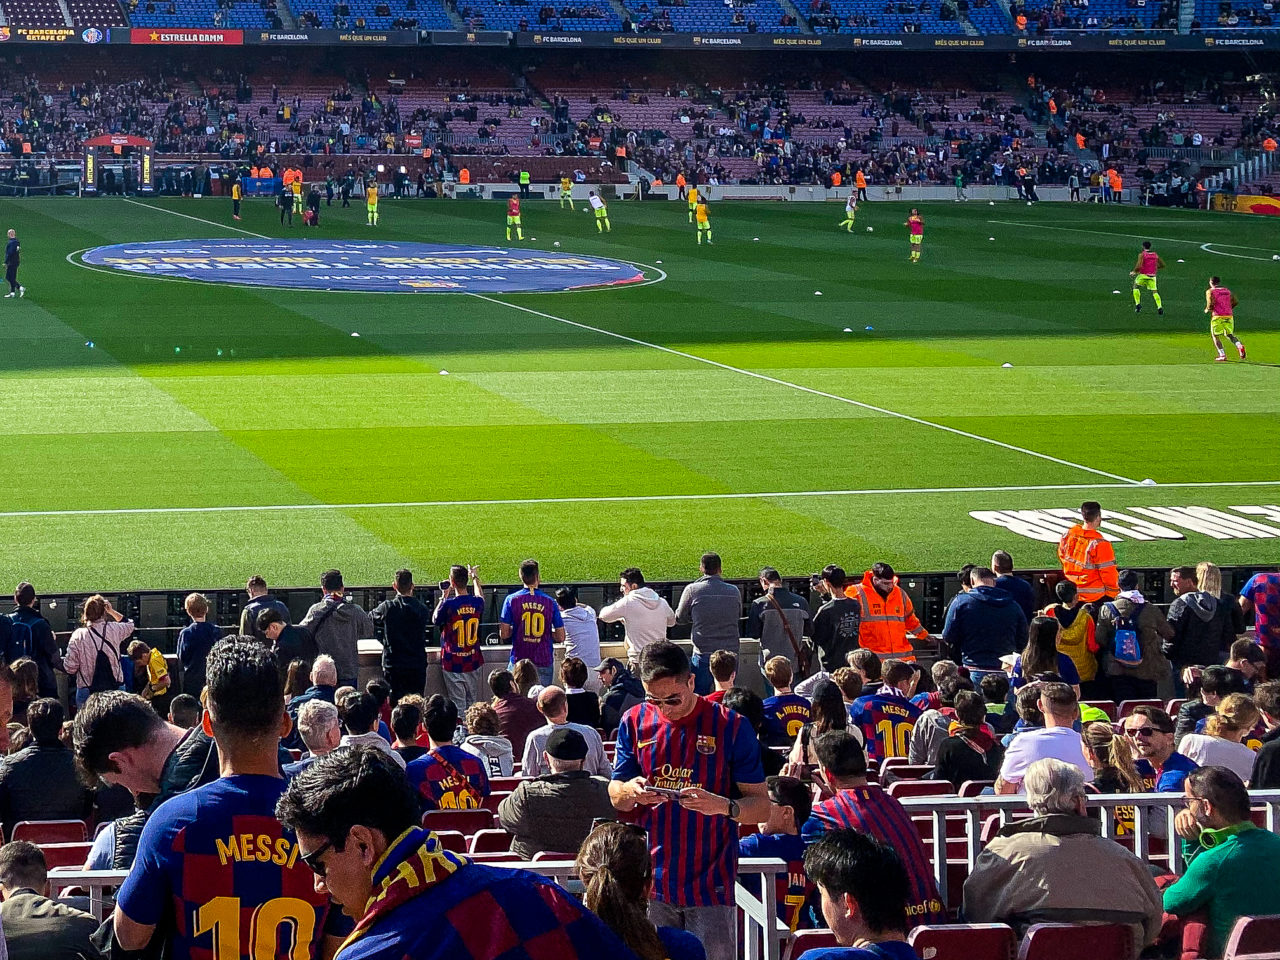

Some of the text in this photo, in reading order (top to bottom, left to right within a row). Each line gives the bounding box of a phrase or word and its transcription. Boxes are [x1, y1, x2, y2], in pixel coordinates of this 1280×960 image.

[199, 34, 223, 42] DAMM
[457, 606, 476, 616] MESSI
[522, 602, 545, 613] MESSI
[453, 617, 479, 648] 10
[522, 611, 545, 637] 10
[784, 705, 810, 718] INIESTA
[881, 704, 909, 718] MESSI
[877, 719, 914, 757] 10
[661, 763, 694, 780] Qatar
[440, 789, 478, 810] 10
[215, 833, 300, 869] MESSI
[193, 896, 316, 960] 10
